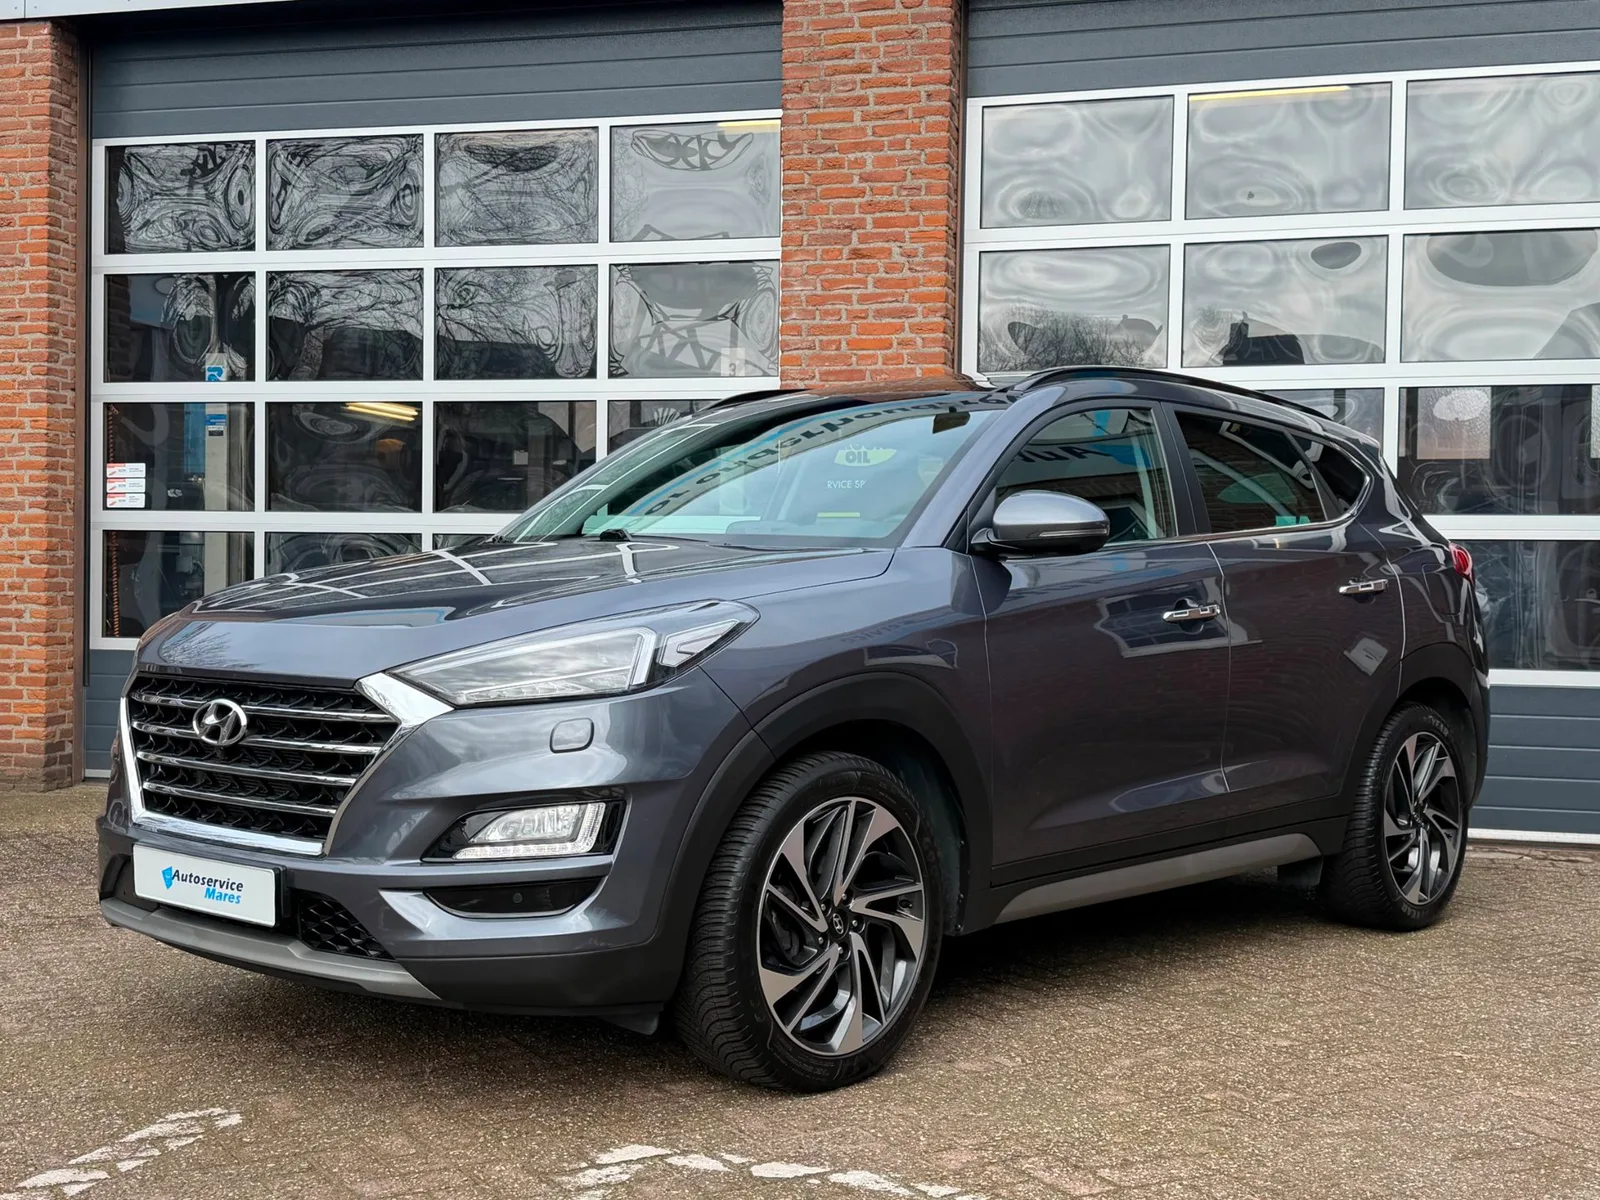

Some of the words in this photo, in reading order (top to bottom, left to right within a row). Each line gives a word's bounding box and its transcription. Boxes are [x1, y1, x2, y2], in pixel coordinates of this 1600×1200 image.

[845, 450, 870, 464] OIL
[171, 869, 244, 892] Autoservice
[204, 887, 242, 905] Mares
